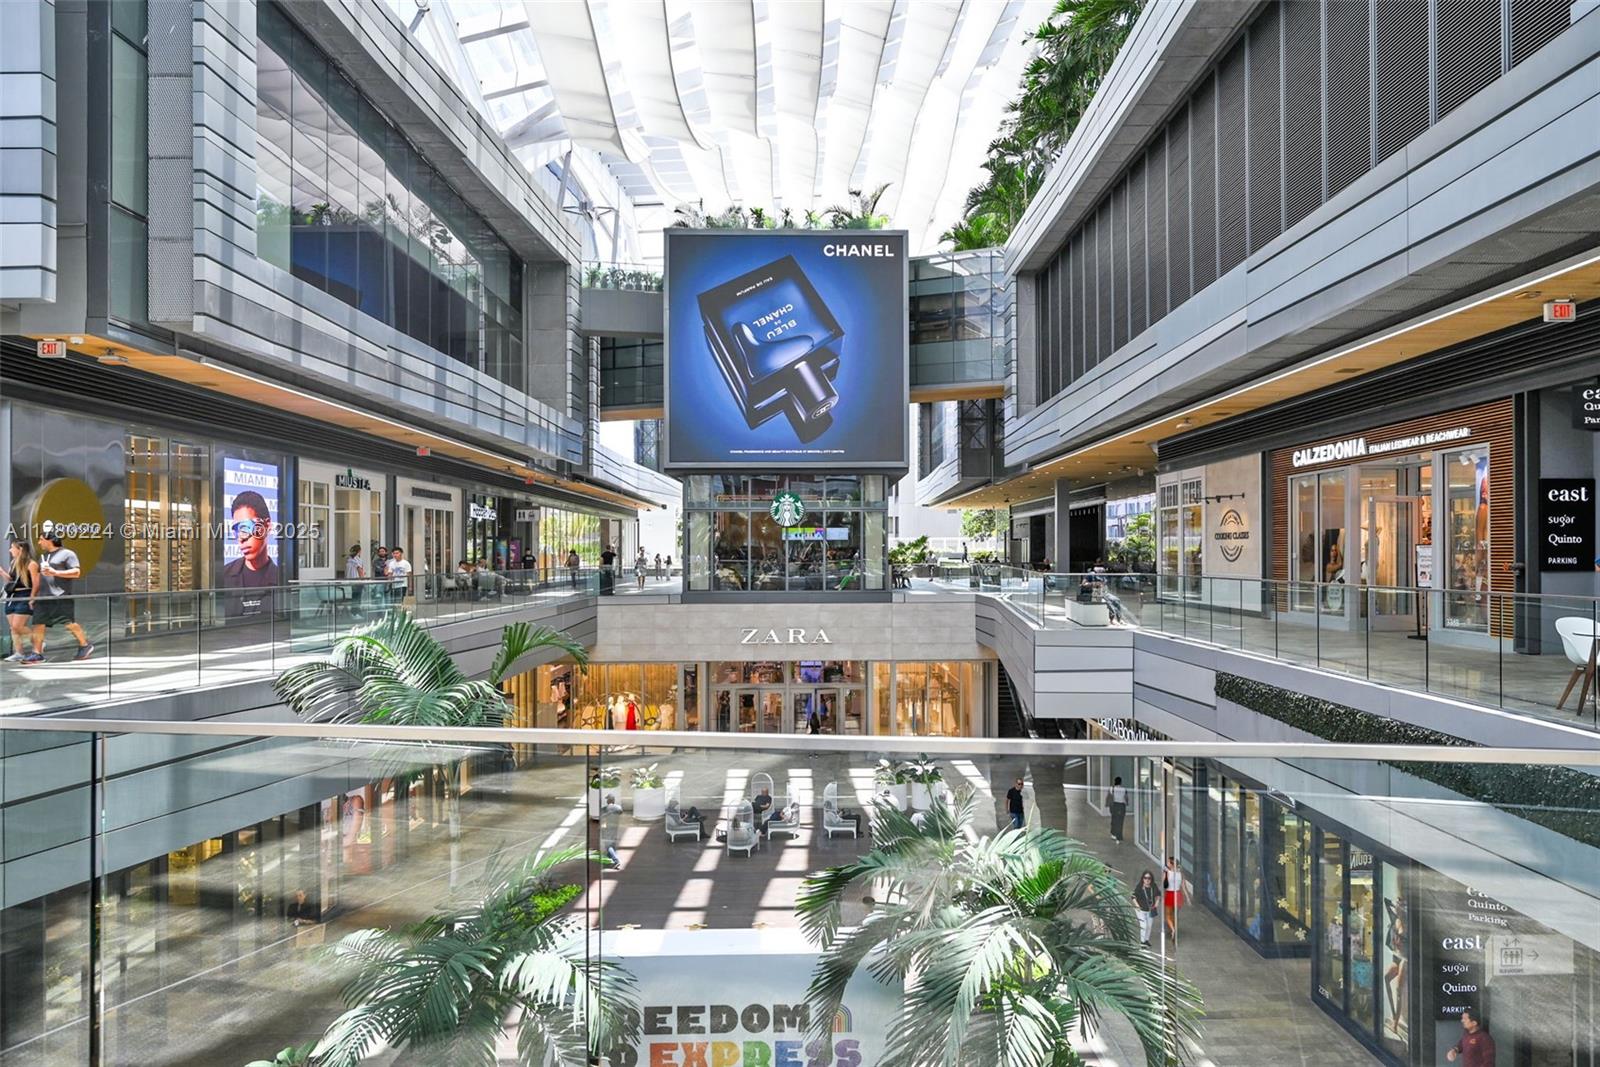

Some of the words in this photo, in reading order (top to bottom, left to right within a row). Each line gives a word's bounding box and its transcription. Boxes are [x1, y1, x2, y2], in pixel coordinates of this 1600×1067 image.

[823, 244, 895, 257] CHANEL
[752, 303, 794, 328] CHANEL
[766, 319, 797, 340] BLEU
[42, 343, 57, 355] EXIT
[1292, 437, 1367, 468] CALZEDONIA
[233, 472, 268, 486] MIAMI
[1548, 486, 1589, 501] east
[1548, 515, 1575, 527] sugar
[1548, 533, 1582, 546] Quinto
[740, 628, 833, 644] ZARA
[1467, 899, 1508, 911] Quinto
[1468, 913, 1508, 926] Parking
[1442, 935, 1484, 950] east
[1442, 963, 1469, 975] sugar
[1442, 982, 1477, 995] Quinto
